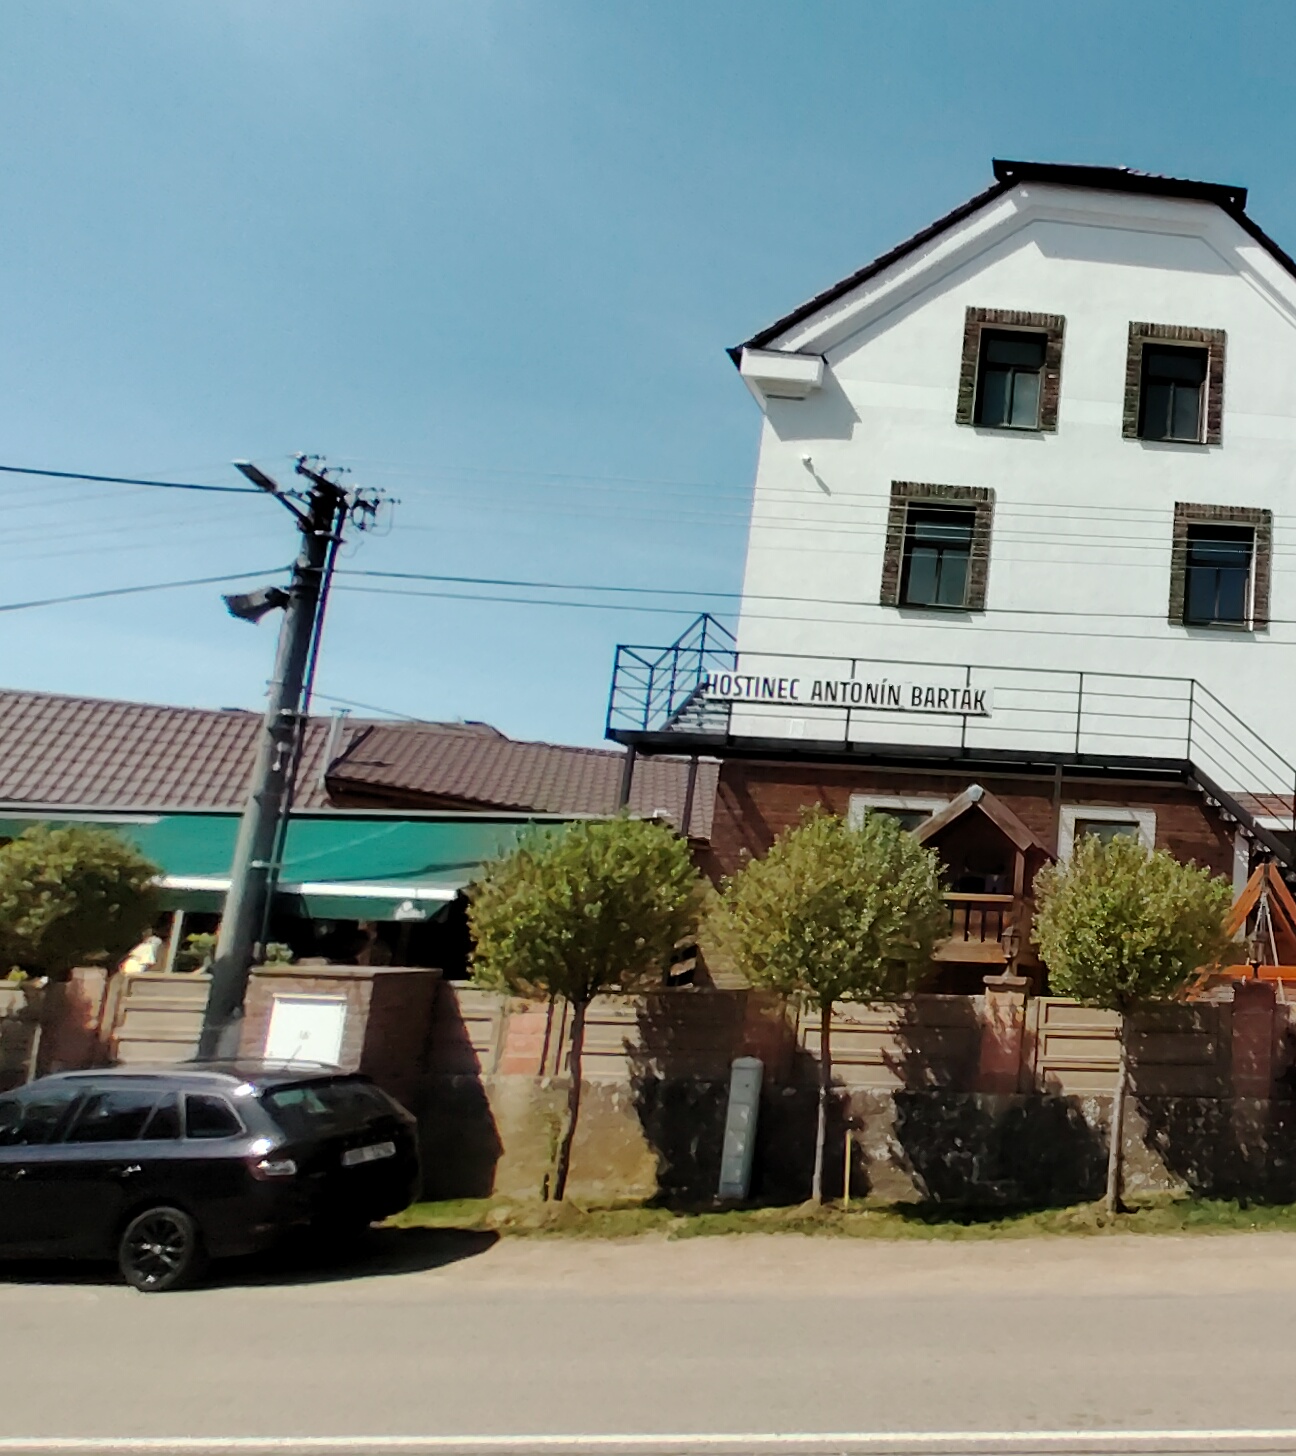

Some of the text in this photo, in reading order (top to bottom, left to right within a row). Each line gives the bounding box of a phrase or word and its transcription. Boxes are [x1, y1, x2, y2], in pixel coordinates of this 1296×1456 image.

[705, 673, 987, 711] HOSTINEC ANTONÍN BARTÁK
